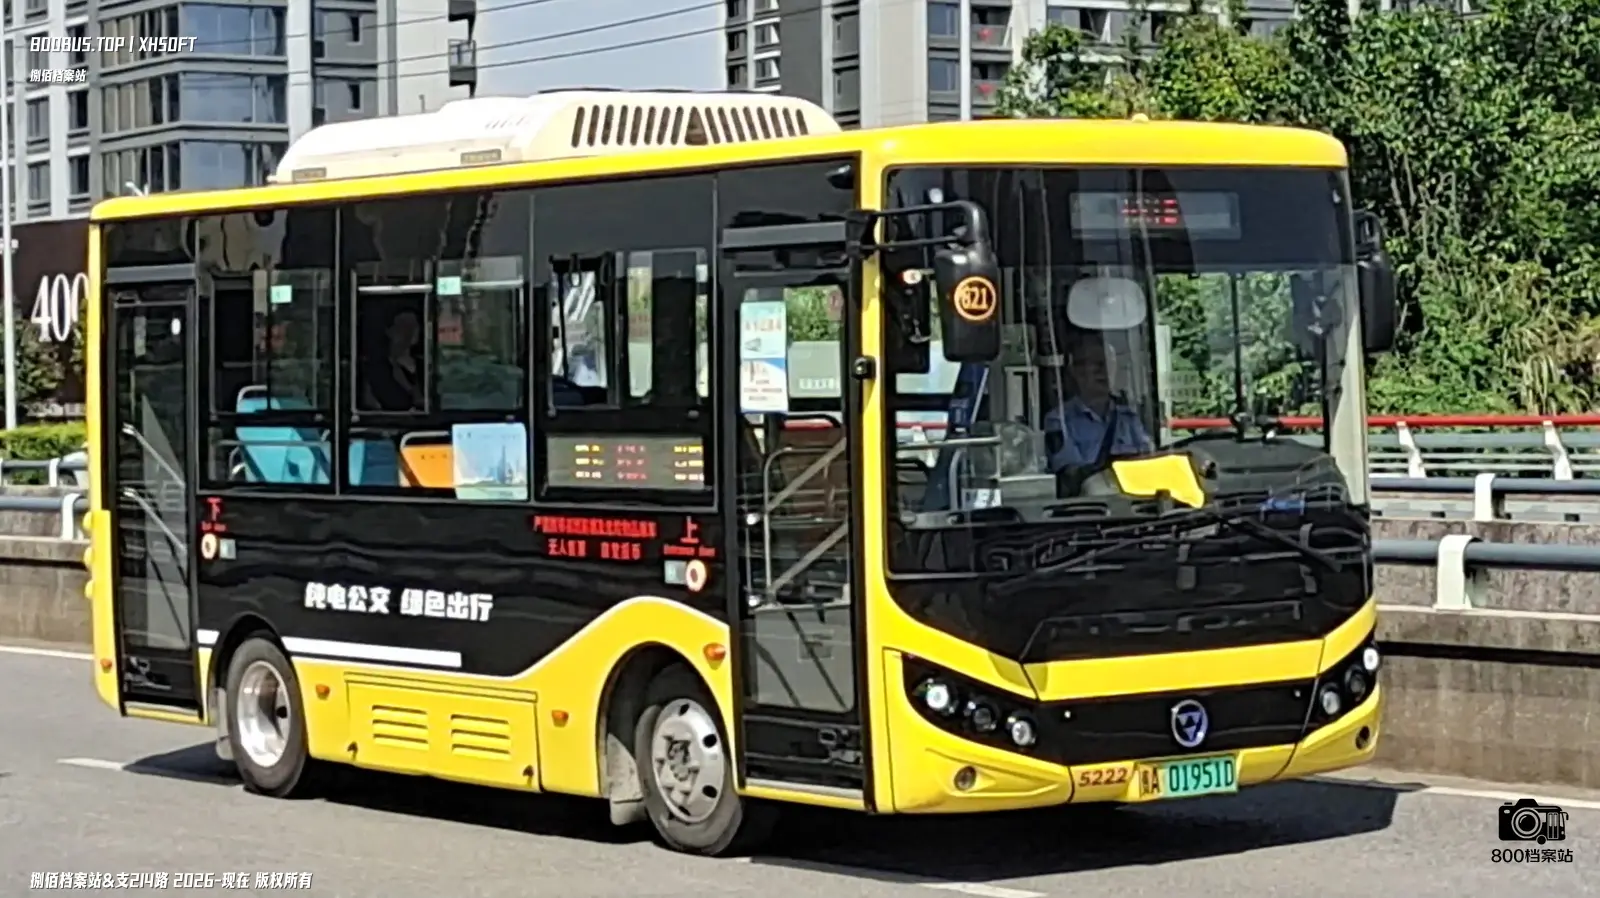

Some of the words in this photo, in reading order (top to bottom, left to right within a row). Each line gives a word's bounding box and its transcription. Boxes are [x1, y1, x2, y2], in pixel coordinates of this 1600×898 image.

[680, 516, 699, 544] 上
[304, 582, 391, 614] 纯电公交
[400, 588, 493, 622] 绿色出行
[1079, 767, 1128, 787] 5222
[1169, 759, 1234, 792] 01951D
